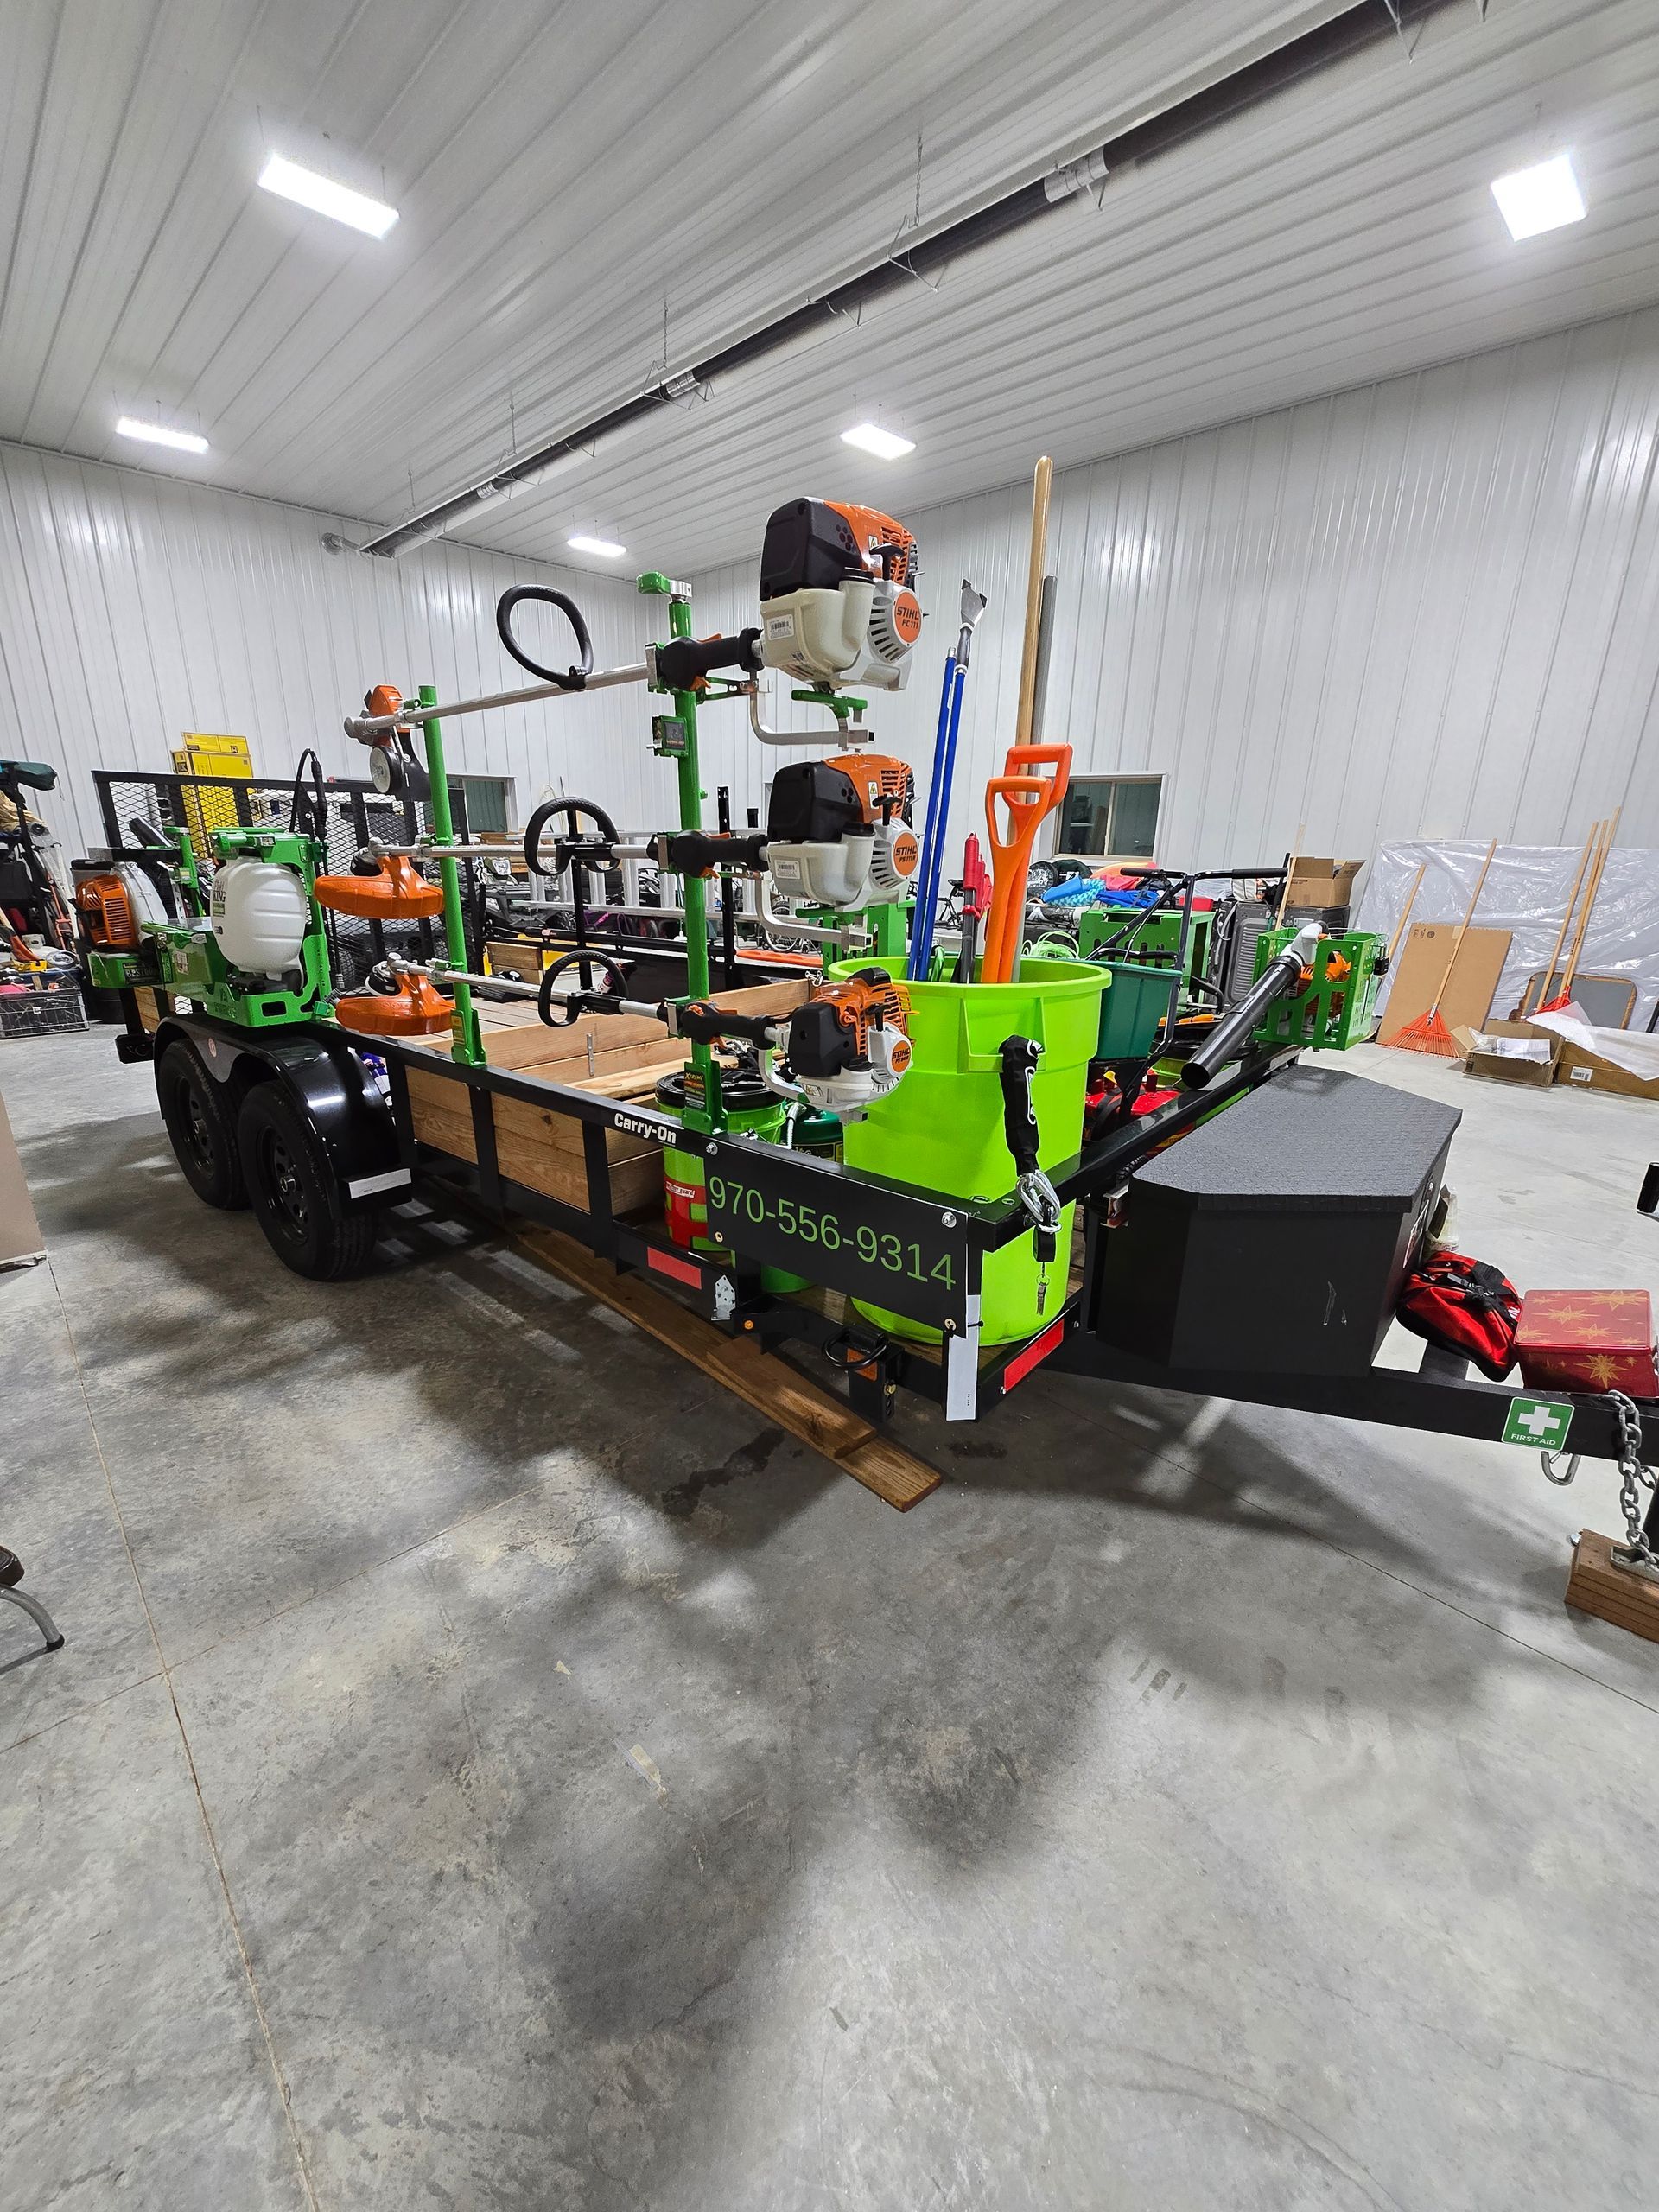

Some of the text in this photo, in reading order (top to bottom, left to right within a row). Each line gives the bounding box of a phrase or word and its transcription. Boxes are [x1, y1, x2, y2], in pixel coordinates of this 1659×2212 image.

[896, 606, 919, 620] STIHL
[895, 846, 917, 856] STIHL
[892, 1047, 911, 1060] STIHL
[614, 1113, 677, 1144] Carry-On
[709, 1176, 957, 1291] 970-556-9314
[1510, 1433, 1538, 1442] FIRST
